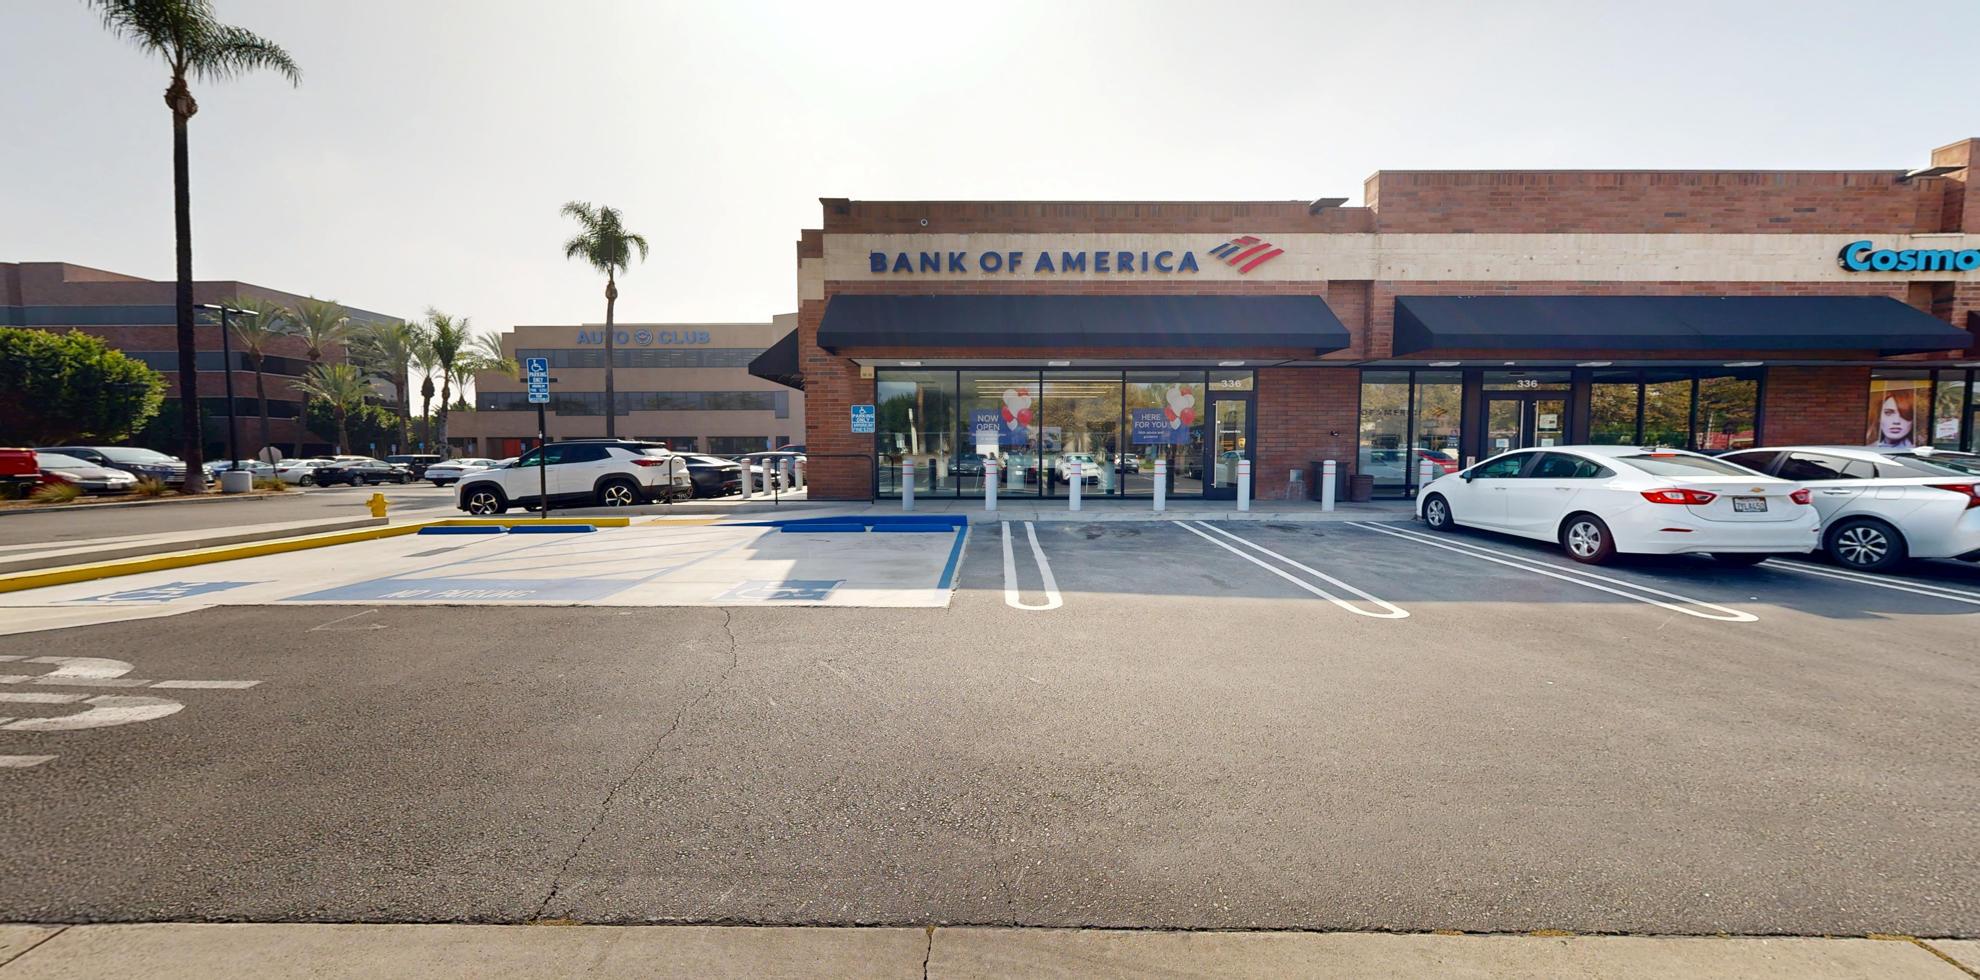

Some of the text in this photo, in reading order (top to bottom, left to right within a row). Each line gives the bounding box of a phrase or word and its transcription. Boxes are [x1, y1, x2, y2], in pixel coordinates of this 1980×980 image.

[870, 251, 1200, 274] BANK OF AMERICA
[576, 329, 711, 345] AUO CLUB
[1221, 379, 1242, 388] 336
[1517, 379, 1538, 388] 336
[977, 414, 999, 422] NOW
[976, 423, 1000, 431] OPEN
[376, 589, 432, 599] NO
